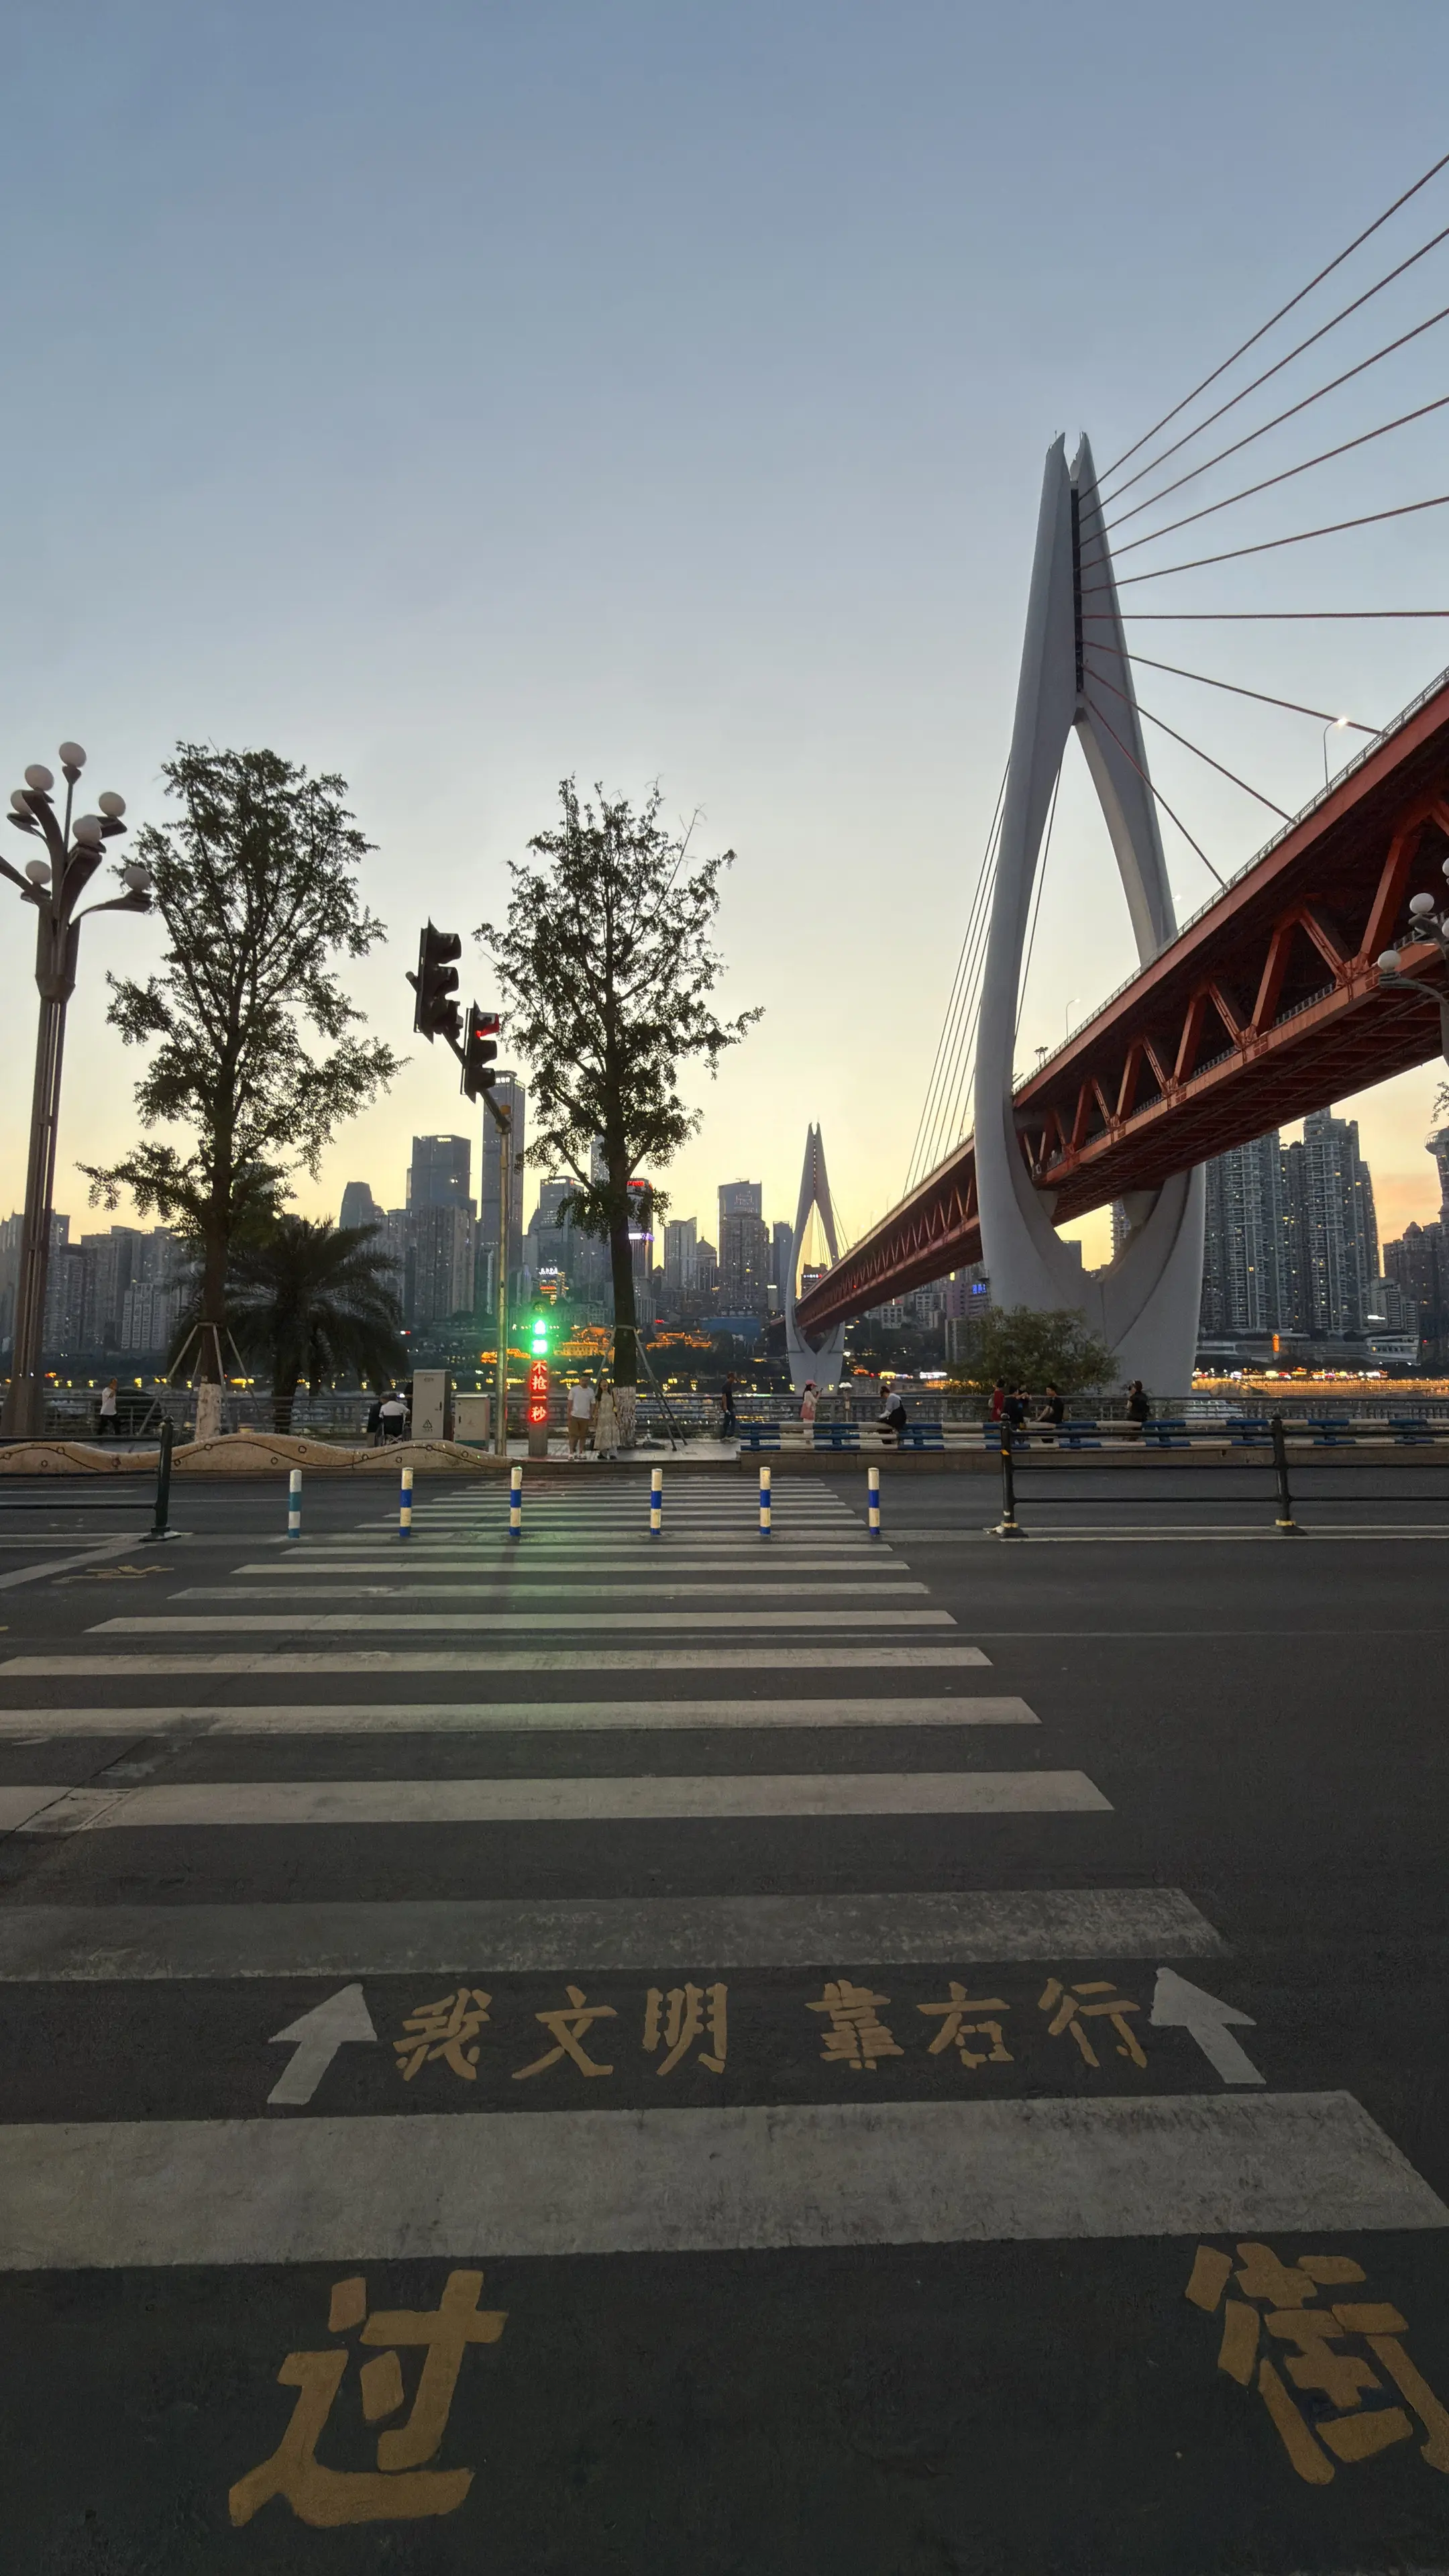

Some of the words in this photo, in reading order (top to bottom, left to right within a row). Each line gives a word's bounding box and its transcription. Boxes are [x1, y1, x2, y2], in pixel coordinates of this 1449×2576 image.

[531, 1360, 547, 1421] 不抢一秒
[393, 1982, 728, 2081] 我文明
[806, 1978, 1147, 2069] 靠右行
[229, 2269, 508, 2528] 过
[1185, 2243, 1449, 2485] 街
